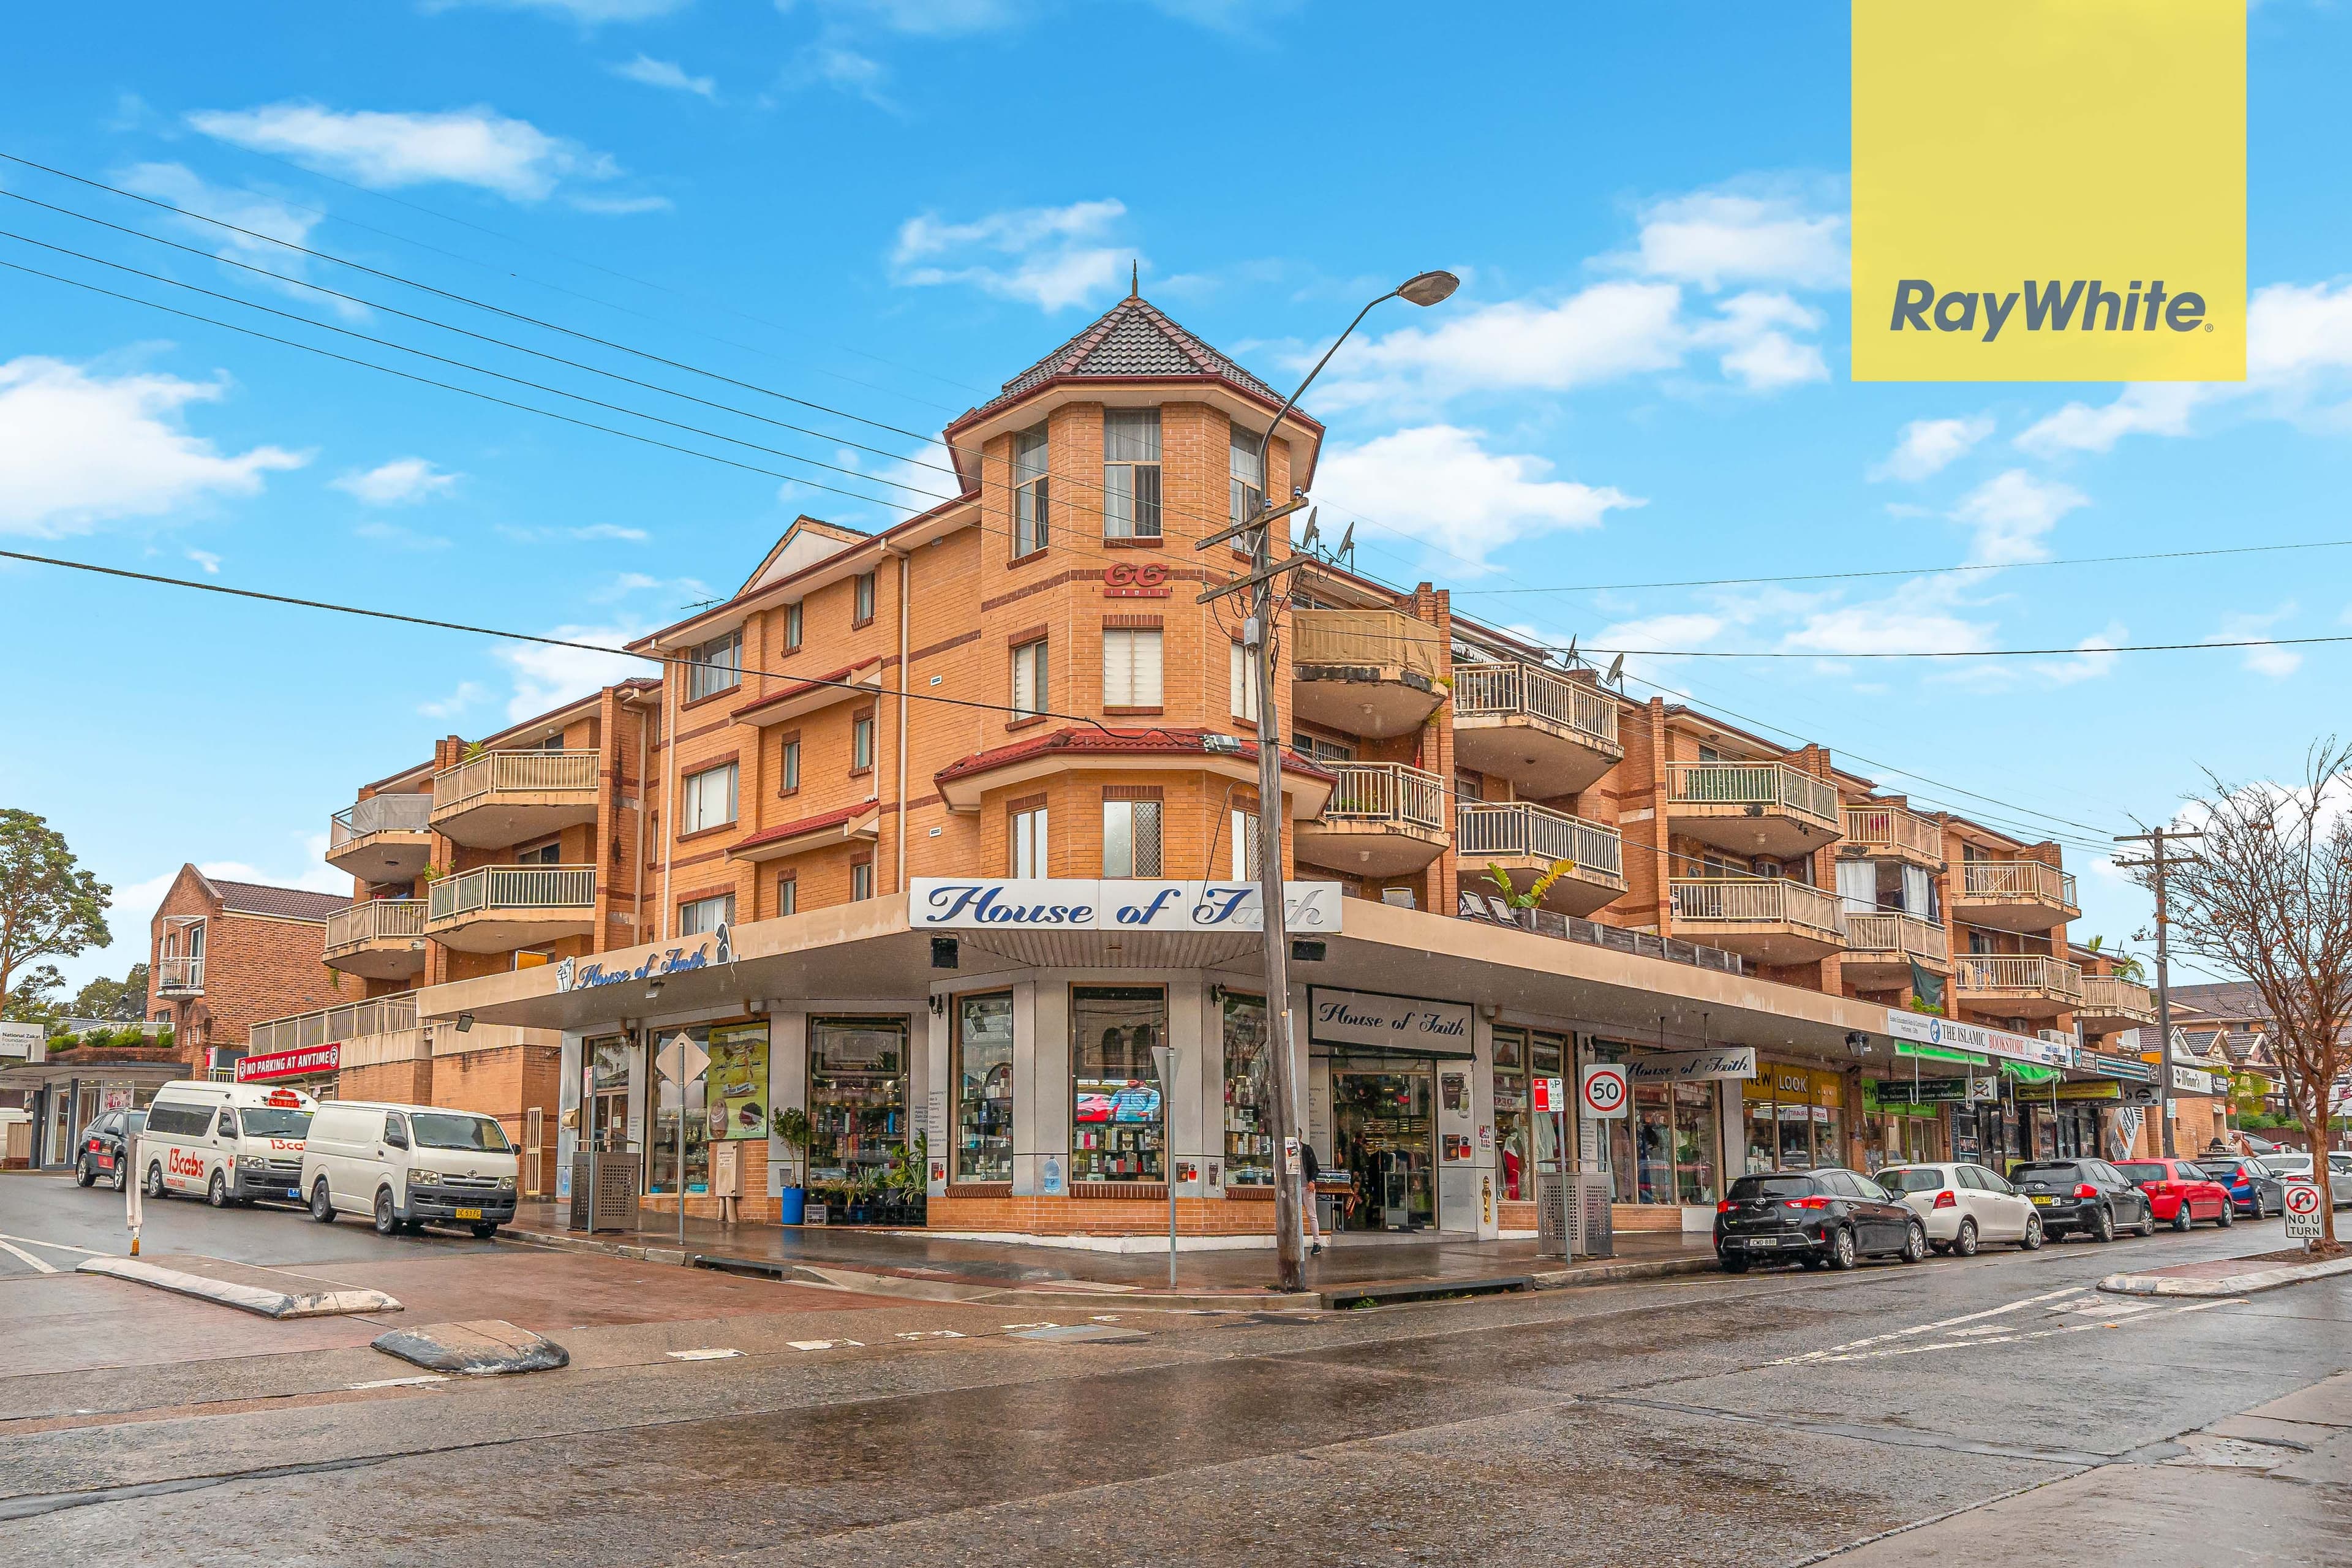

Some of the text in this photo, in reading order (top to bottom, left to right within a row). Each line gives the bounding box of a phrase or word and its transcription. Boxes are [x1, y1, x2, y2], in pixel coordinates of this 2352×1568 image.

[925, 886, 1324, 925] House of Fath
[578, 963, 631, 989] House
[635, 953, 658, 979] of
[1319, 1003, 1466, 1036] House of Faith
[1942, 1024, 1956, 1041] THE
[1958, 1027, 1986, 1047] ISLAMIC
[1988, 1034, 2025, 1055] BOOKSTORE
[246, 1051, 330, 1075] NO PARKING AT ANYTIME
[1625, 1055, 1749, 1077] House of Faith
[1593, 1082, 1619, 1100] 50
[1778, 1074, 1807, 1093] LOOK
[270, 1139, 306, 1151] 13ca
[168, 1148, 205, 1178] 13cabs
[2288, 1214, 2320, 1224] NO U
[2290, 1227, 2320, 1235] TURN
